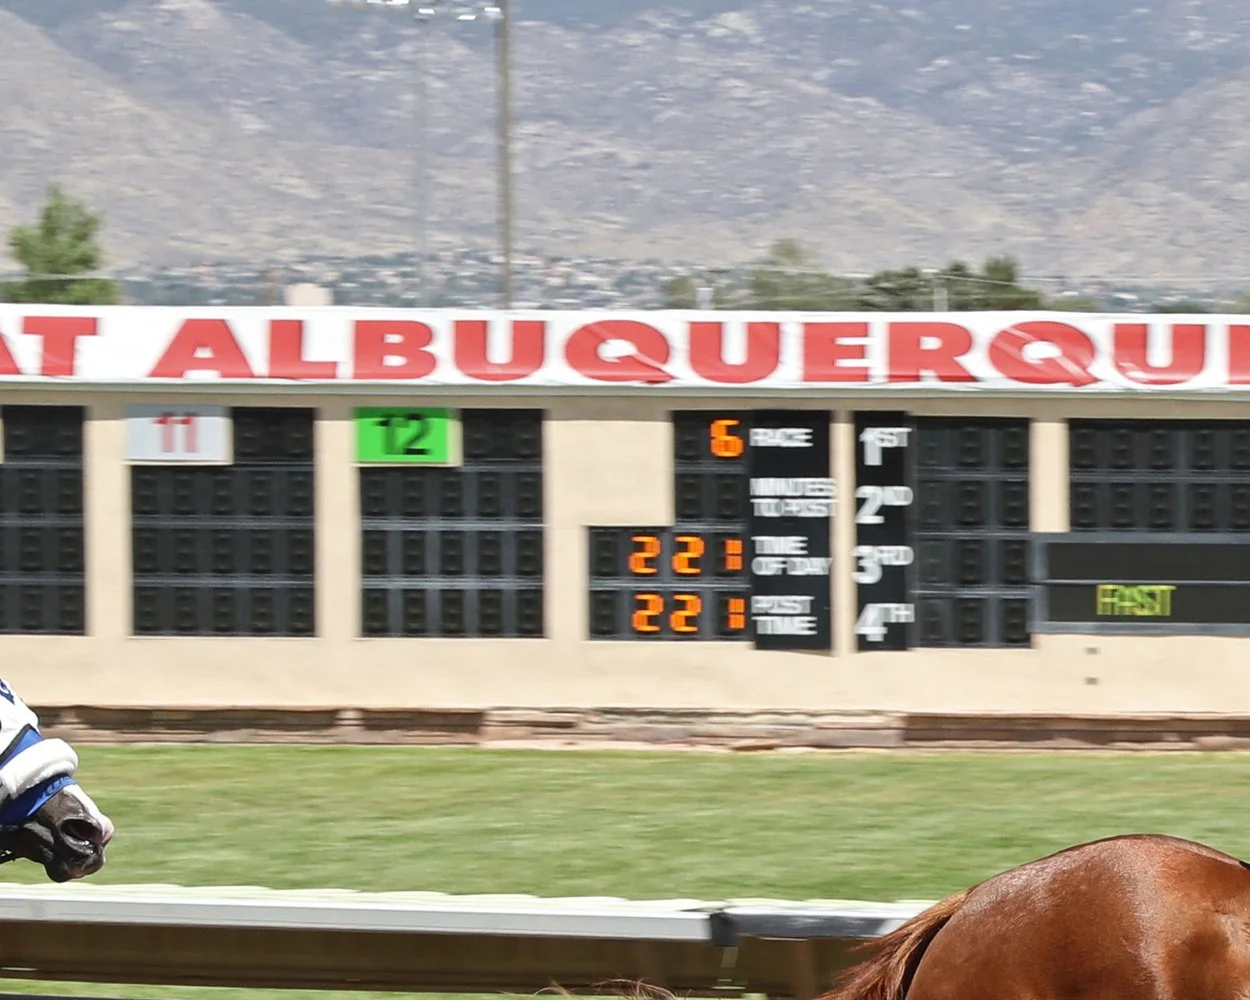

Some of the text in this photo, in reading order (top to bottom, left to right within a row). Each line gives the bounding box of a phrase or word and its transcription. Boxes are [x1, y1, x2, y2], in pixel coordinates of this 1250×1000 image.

[153, 411, 200, 453] 11
[376, 413, 431, 456] 12
[710, 419, 744, 457] 6
